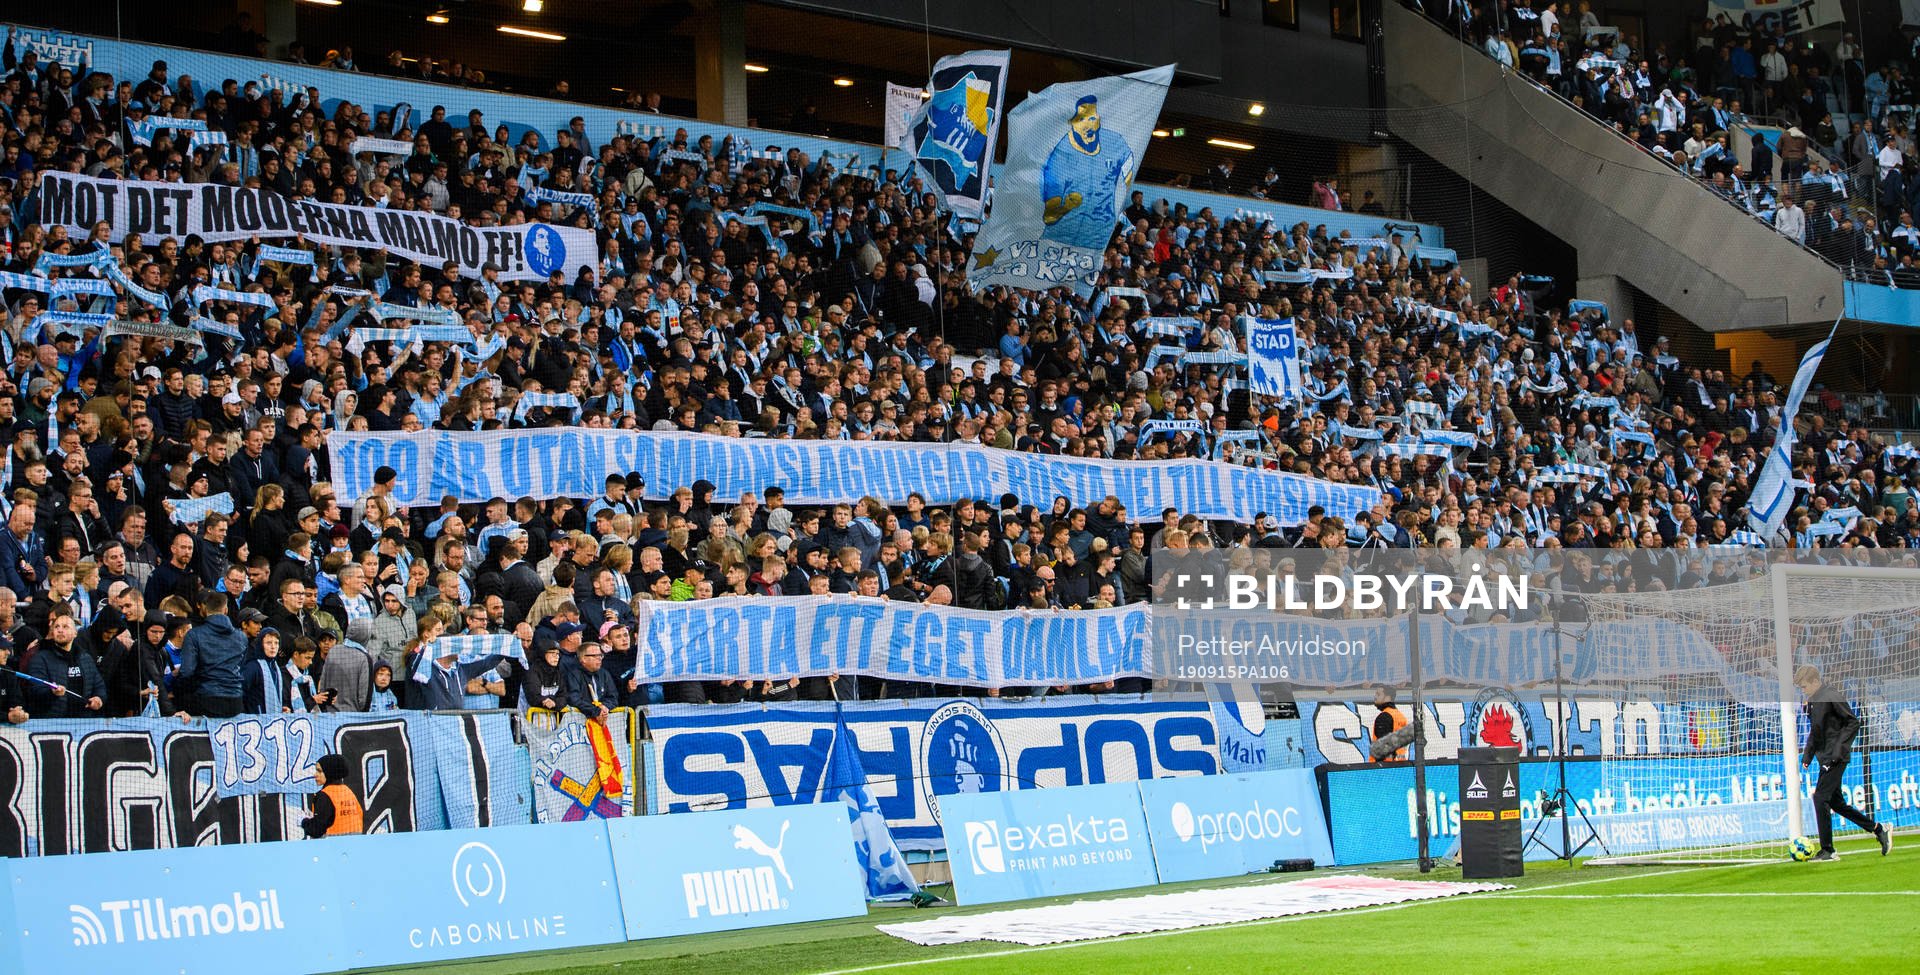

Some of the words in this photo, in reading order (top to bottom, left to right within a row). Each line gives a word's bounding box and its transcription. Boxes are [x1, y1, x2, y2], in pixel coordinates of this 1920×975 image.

[43, 176, 118, 231] MOT
[128, 187, 193, 235] DET
[202, 186, 376, 242] MODERNA
[376, 211, 480, 269] MALMÖ
[483, 231, 524, 272] FF!
[1255, 333, 1291, 350] STAD
[338, 438, 418, 501] 109
[430, 430, 491, 500] ÅR
[500, 432, 606, 497] UTAN
[1004, 453, 1110, 513] RÖSTA
[1112, 465, 1162, 518] NEJ
[1167, 464, 1228, 514] TILL
[644, 603, 800, 678] STARTA
[810, 603, 885, 670] ETT
[886, 610, 991, 681] EGET
[1002, 610, 1146, 680] DAMLAG
[1152, 610, 1223, 677] FRÅN
[927, 706, 959, 736] SCANIA
[962, 706, 992, 733] ULTRAS
[213, 718, 316, 789] 1312
[1466, 790, 1489, 799] SELECT
[1004, 812, 1129, 853] exakta
[1201, 801, 1302, 854] prodoc
[1611, 820, 1652, 845] PRISET
[1659, 817, 1686, 841] MED
[1688, 814, 1743, 838] BROPASS
[1009, 856, 1050, 872] PRINT
[1052, 853, 1078, 868] AND
[1082, 849, 1132, 866] BEYOND
[684, 866, 780, 918] PUMA
[101, 888, 285, 945] Tillmobil
[410, 915, 566, 949] CABONLINE
